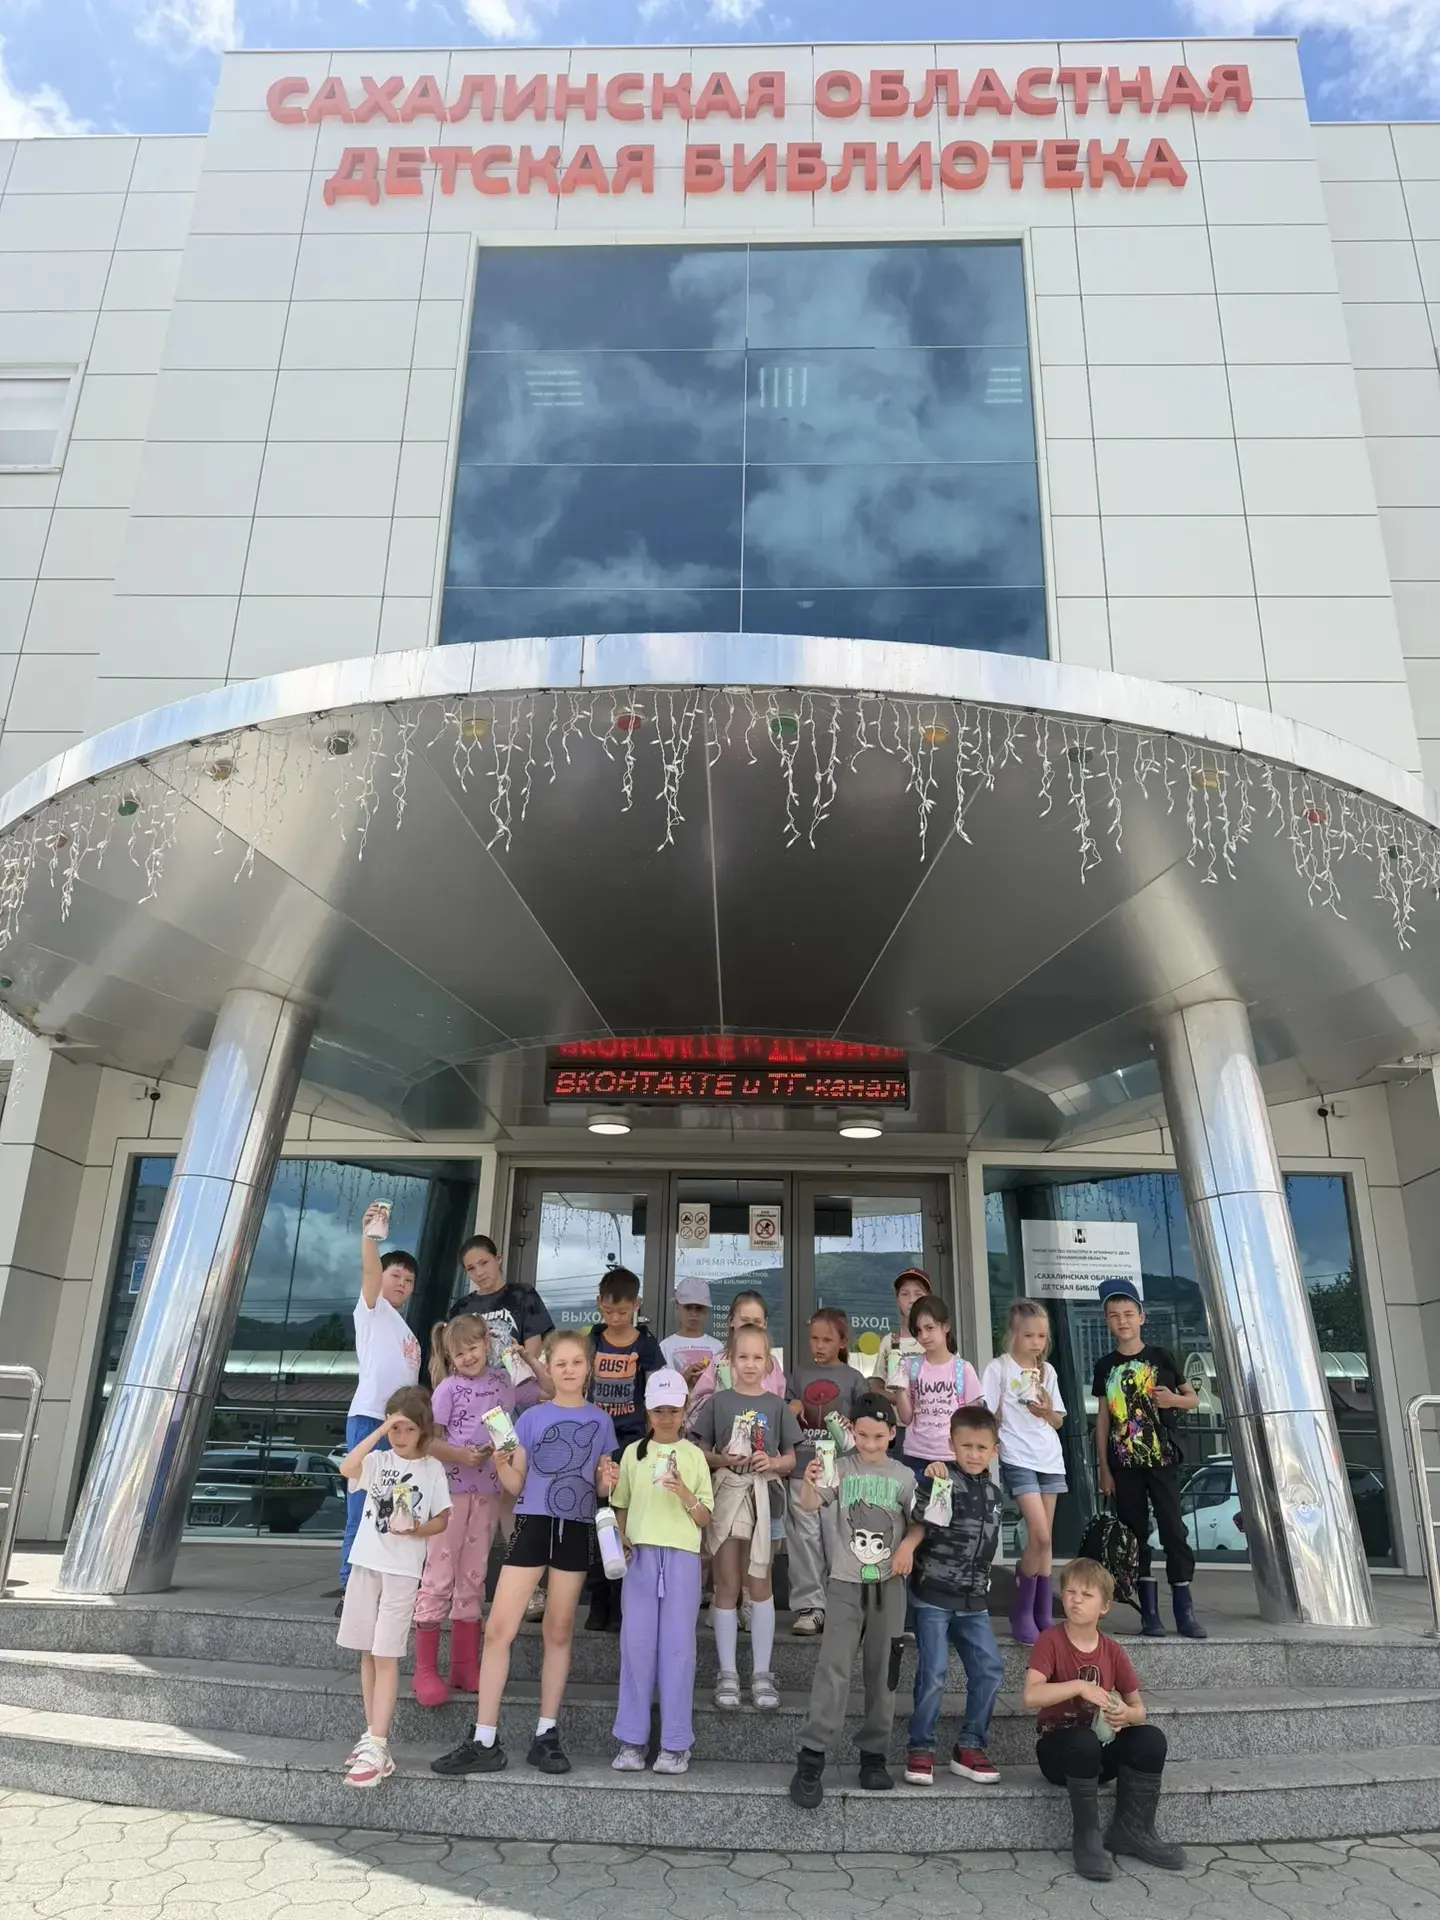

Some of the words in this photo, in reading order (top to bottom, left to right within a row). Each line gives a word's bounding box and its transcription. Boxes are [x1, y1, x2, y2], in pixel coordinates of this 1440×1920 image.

[266, 72, 785, 124] САХАЛИНСКАЯ
[815, 65, 1252, 119] ОБЛАСТНАЯ
[324, 145, 654, 206] ДЕТСКАЯ
[683, 139, 1188, 195] БИБЛИОТЕКА
[555, 1070, 736, 1096] ВКОНТАКТЕ
[696, 1258, 725, 1266] ВРЕМЯ
[1041, 1283, 1074, 1291] ДЕТСКАЯ
[561, 1311, 606, 1323] ВЫХО
[851, 1316, 891, 1329] ВХОД
